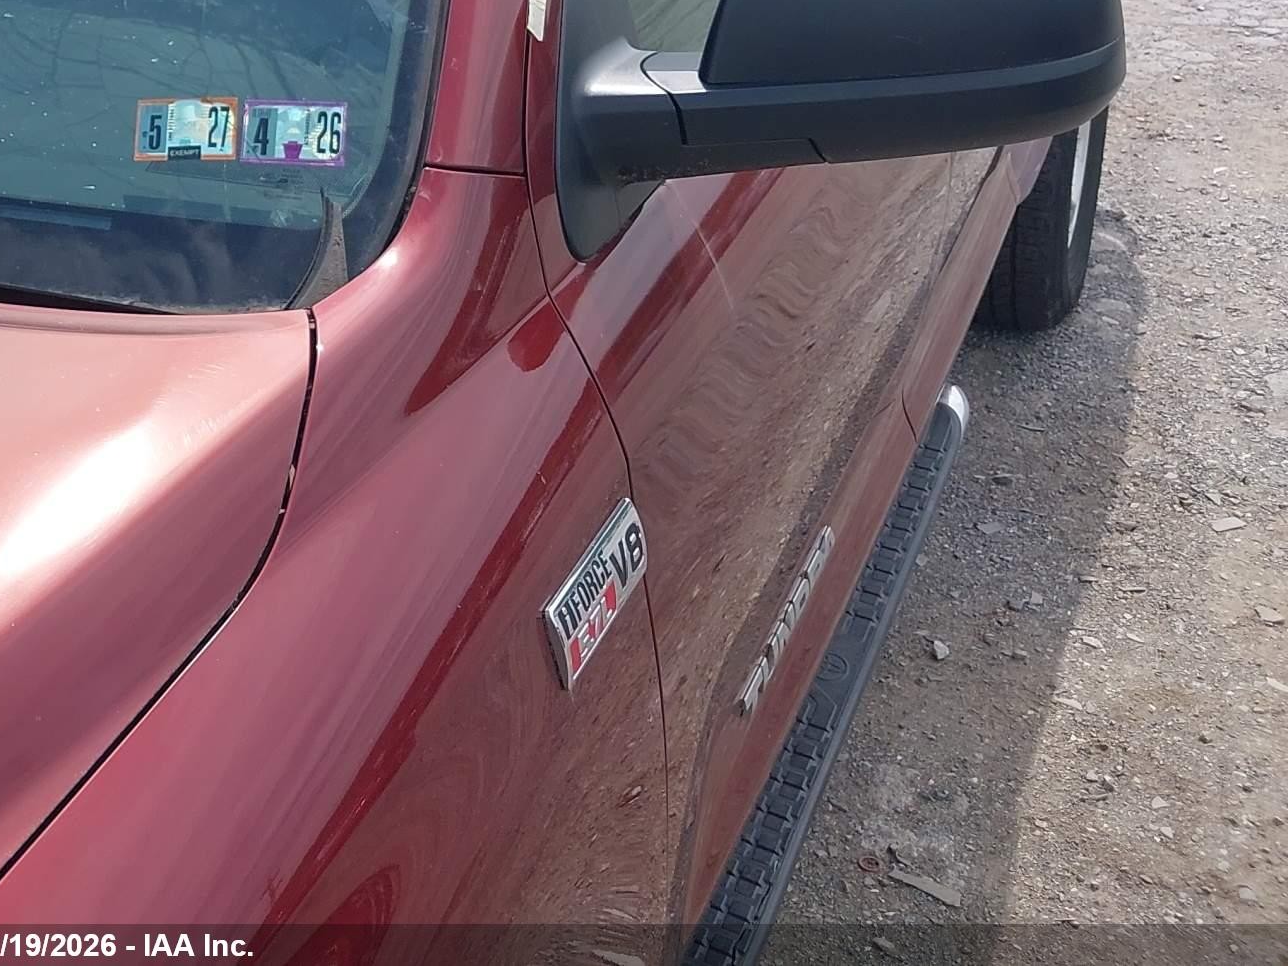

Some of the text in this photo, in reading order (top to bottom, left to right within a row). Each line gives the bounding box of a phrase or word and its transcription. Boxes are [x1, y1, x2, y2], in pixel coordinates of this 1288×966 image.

[148, 114, 162, 151] 5
[207, 105, 230, 149] 27
[253, 117, 269, 156] 4
[316, 110, 342, 155] 26
[609, 522, 645, 589] V8
